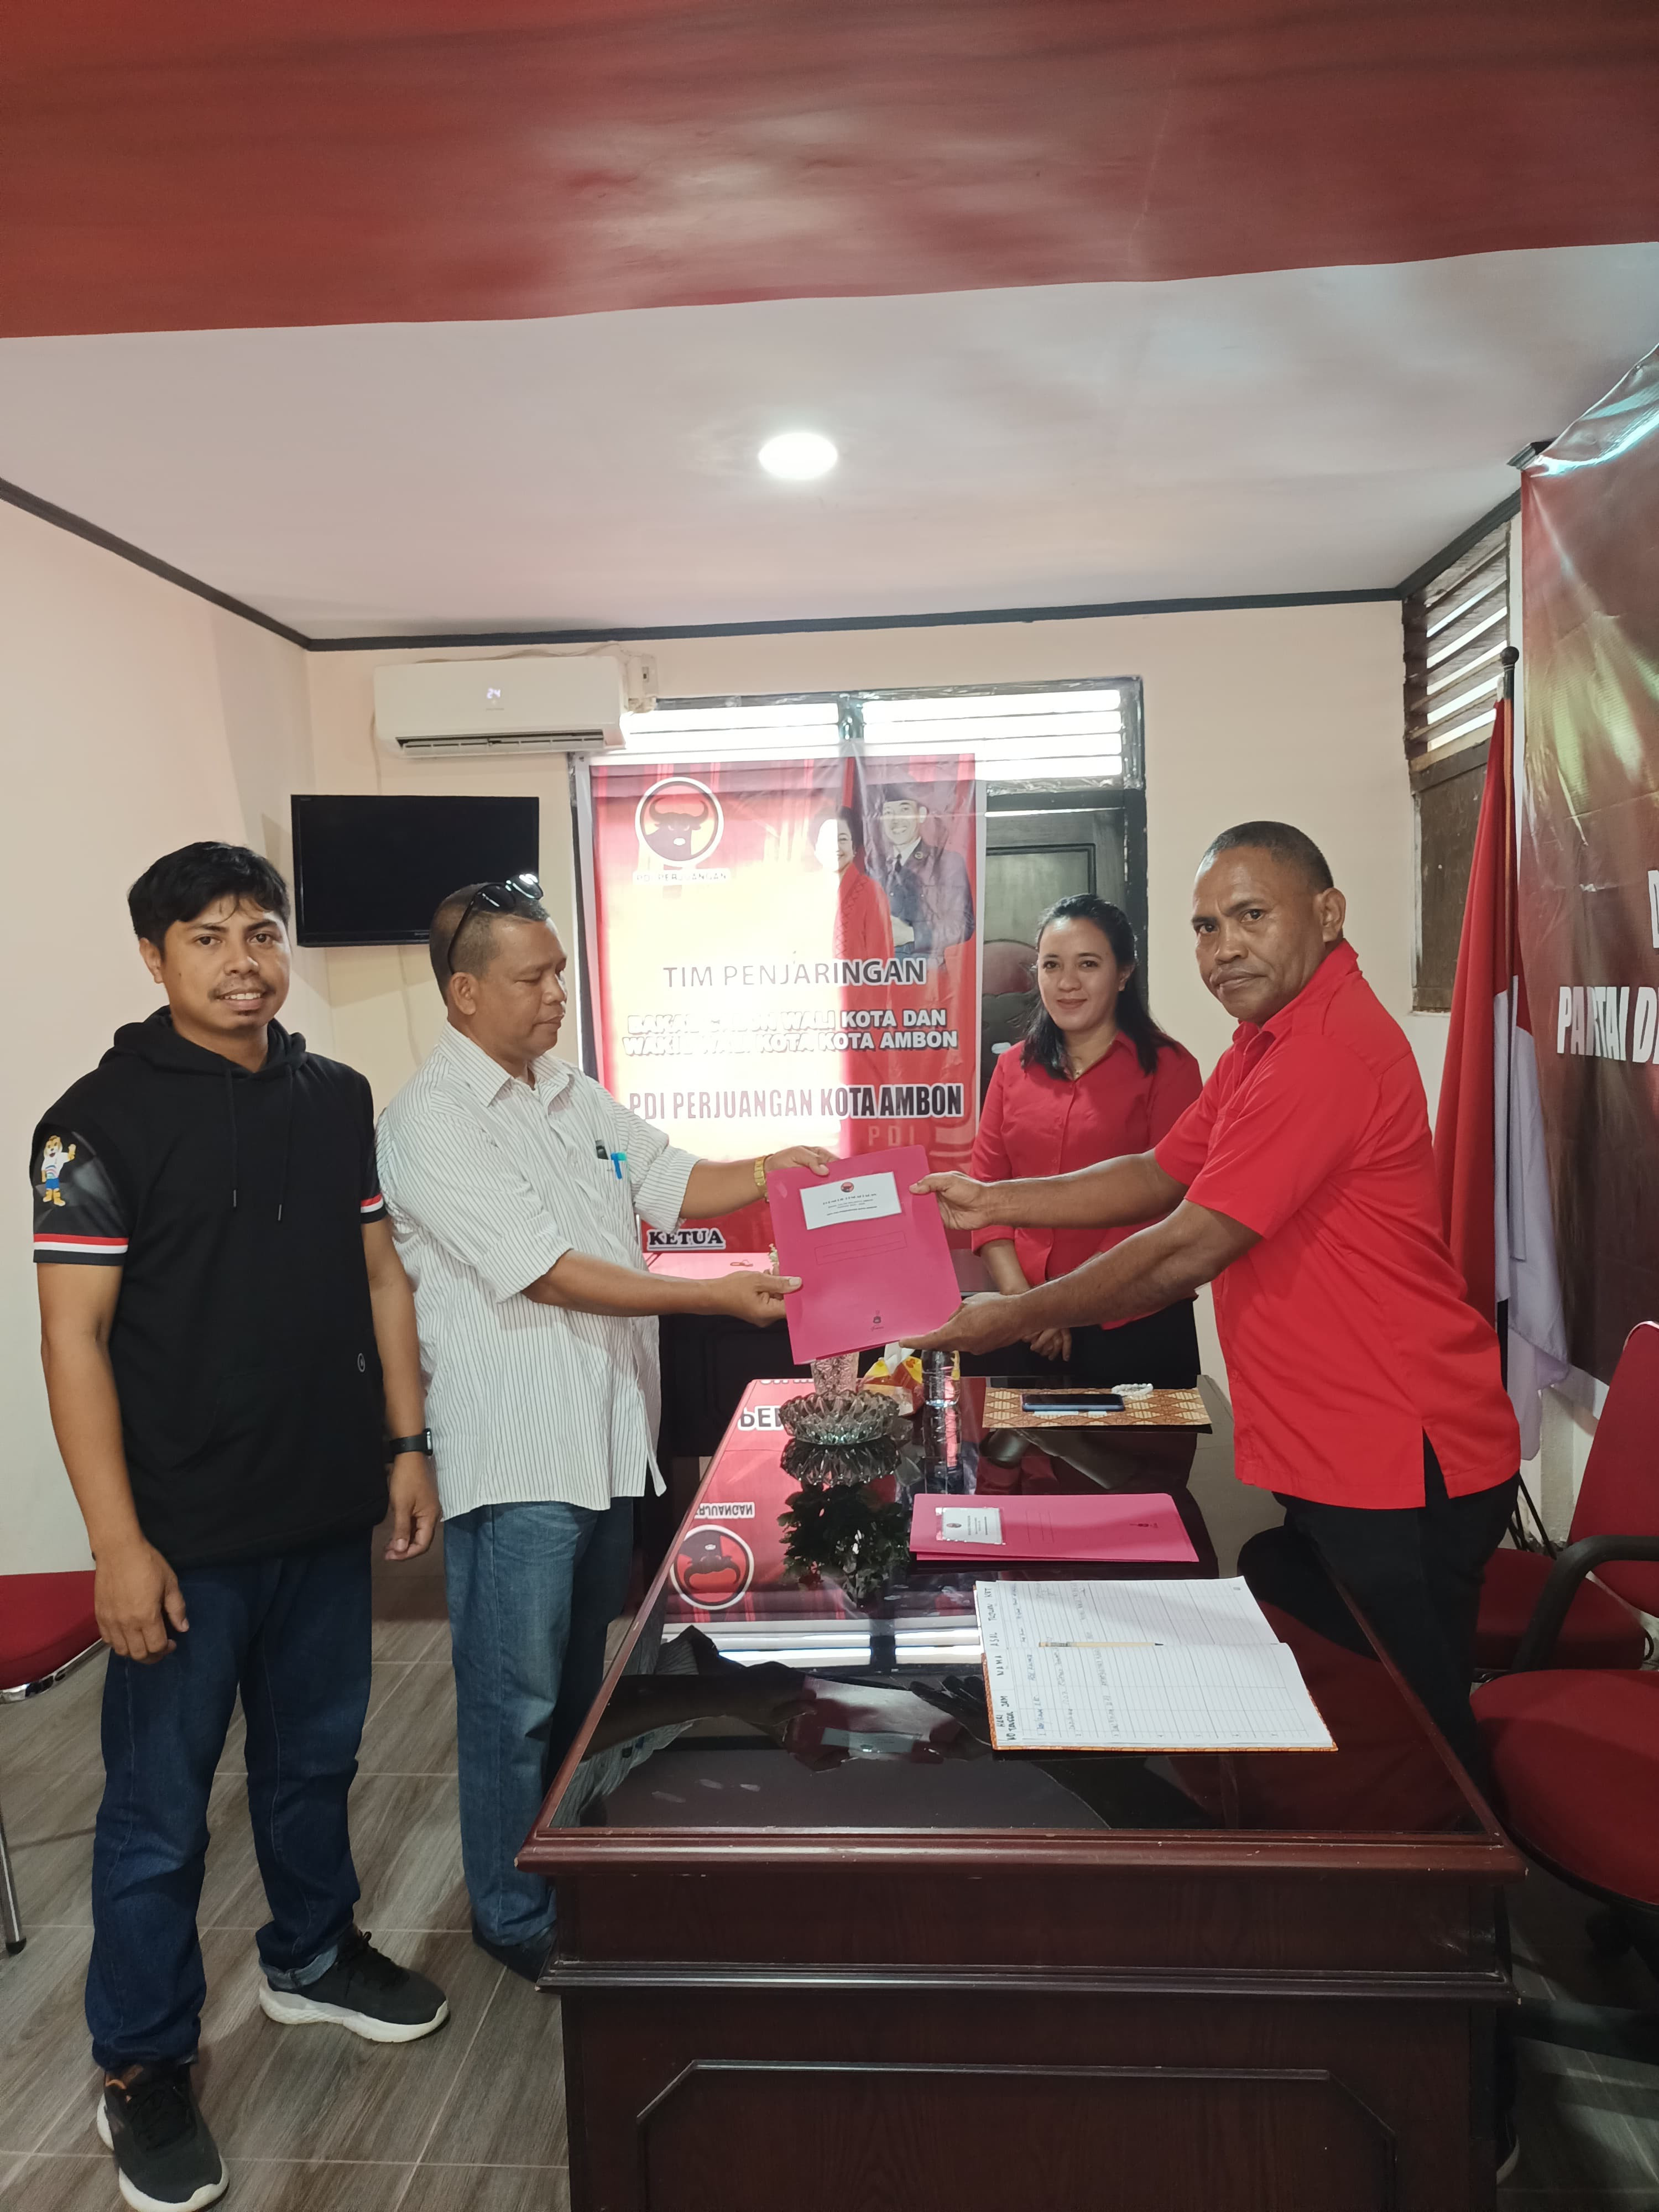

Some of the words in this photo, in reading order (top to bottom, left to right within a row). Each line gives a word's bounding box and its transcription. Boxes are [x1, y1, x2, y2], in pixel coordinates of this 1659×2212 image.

[663, 967, 712, 987] TIM
[724, 960, 924, 985] PENJARINGAN
[780, 1010, 836, 1032] WALI
[841, 1010, 897, 1028] KOTA
[903, 1009, 947, 1027] DAN
[1557, 986, 1630, 1061] PARTAI
[756, 1032, 815, 1054] KOTA
[818, 1032, 875, 1052] KOTA
[880, 1031, 958, 1049] AMBON
[629, 1092, 665, 1120] PDI
[673, 1089, 812, 1119] PERJUANGAN
[821, 1087, 875, 1117] KOTA
[880, 1085, 962, 1116] AMBON
[649, 1229, 723, 1245] KETUA
[989, 1632, 1000, 1646] ASAL
[994, 1655, 1005, 1676] NAMA
